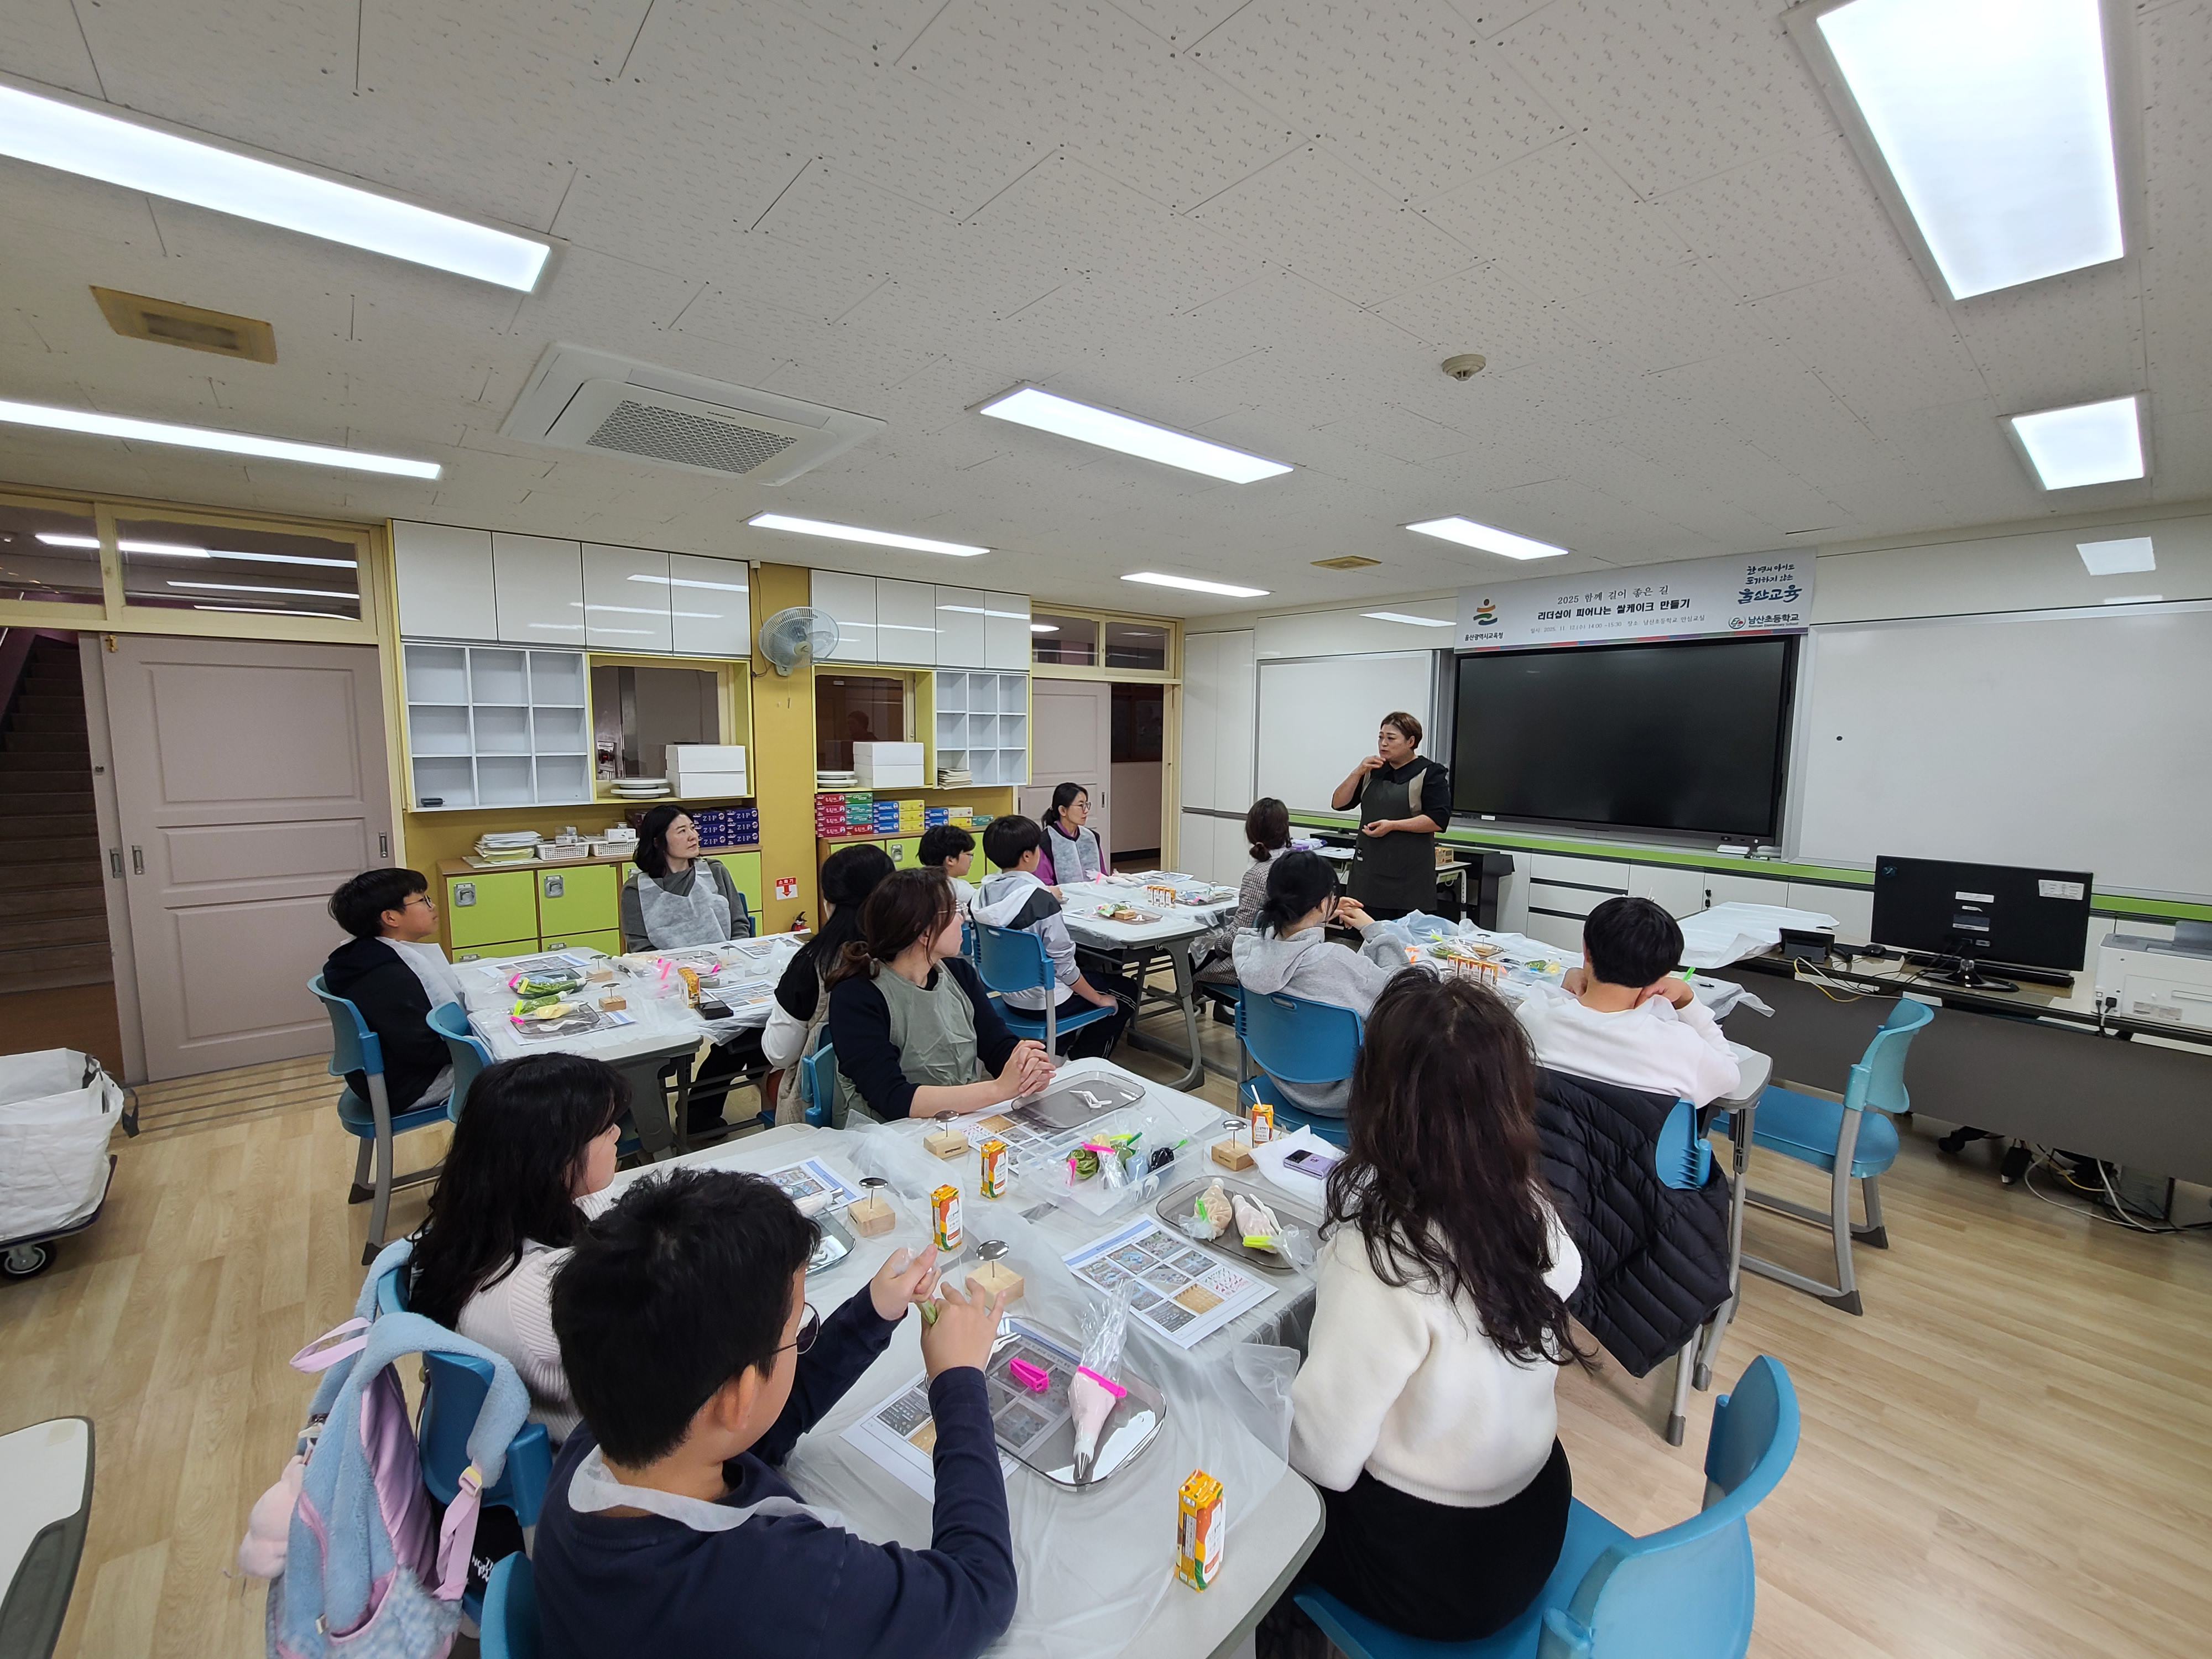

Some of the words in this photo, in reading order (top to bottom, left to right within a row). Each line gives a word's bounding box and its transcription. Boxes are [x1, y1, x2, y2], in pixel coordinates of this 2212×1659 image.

[1747, 566, 1756, 575] 한
[1774, 564, 1795, 572] 아이도
[1745, 575, 1777, 585] 포기하지
[1780, 573, 1793, 582] 않는
[1557, 596, 1579, 604] 2025
[1585, 592, 1603, 603] 함께
[1608, 589, 1626, 600] 길이
[1633, 587, 1653, 598] 좋은
[1660, 585, 1668, 595] 길
[1738, 585, 1802, 604] 울산교육
[1538, 609, 1572, 620] 리더십이
[1576, 606, 1611, 617] 피어나는
[1617, 602, 1654, 614] 쌀케이크
[1660, 598, 1690, 610] 만들기
[1643, 617, 1677, 625] 남산초등학교
[1748, 614, 1799, 624] 남산초등학교
[1464, 632, 1503, 641] 울산광역시교육청
